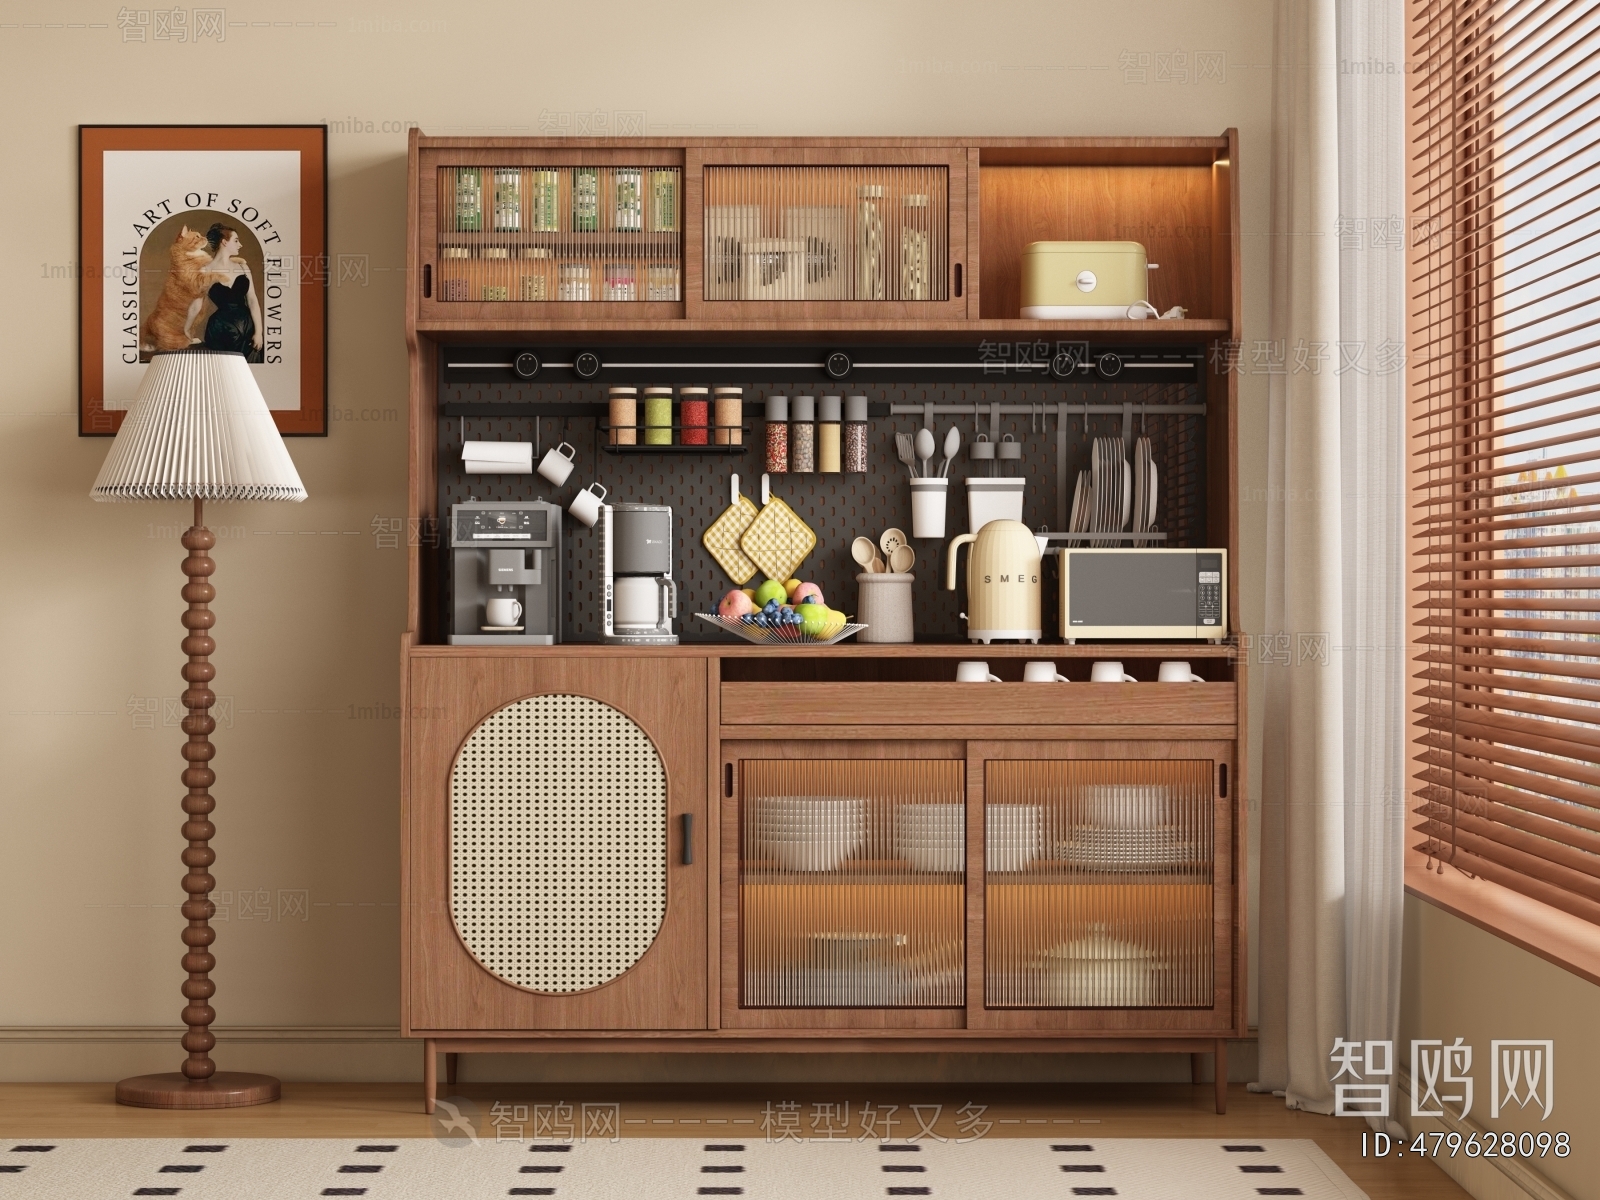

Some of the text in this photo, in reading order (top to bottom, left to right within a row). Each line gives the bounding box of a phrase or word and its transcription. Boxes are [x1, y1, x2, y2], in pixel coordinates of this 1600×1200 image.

[122, 192, 282, 364] CLASSICAL ART OF SOFT FLOWERS
